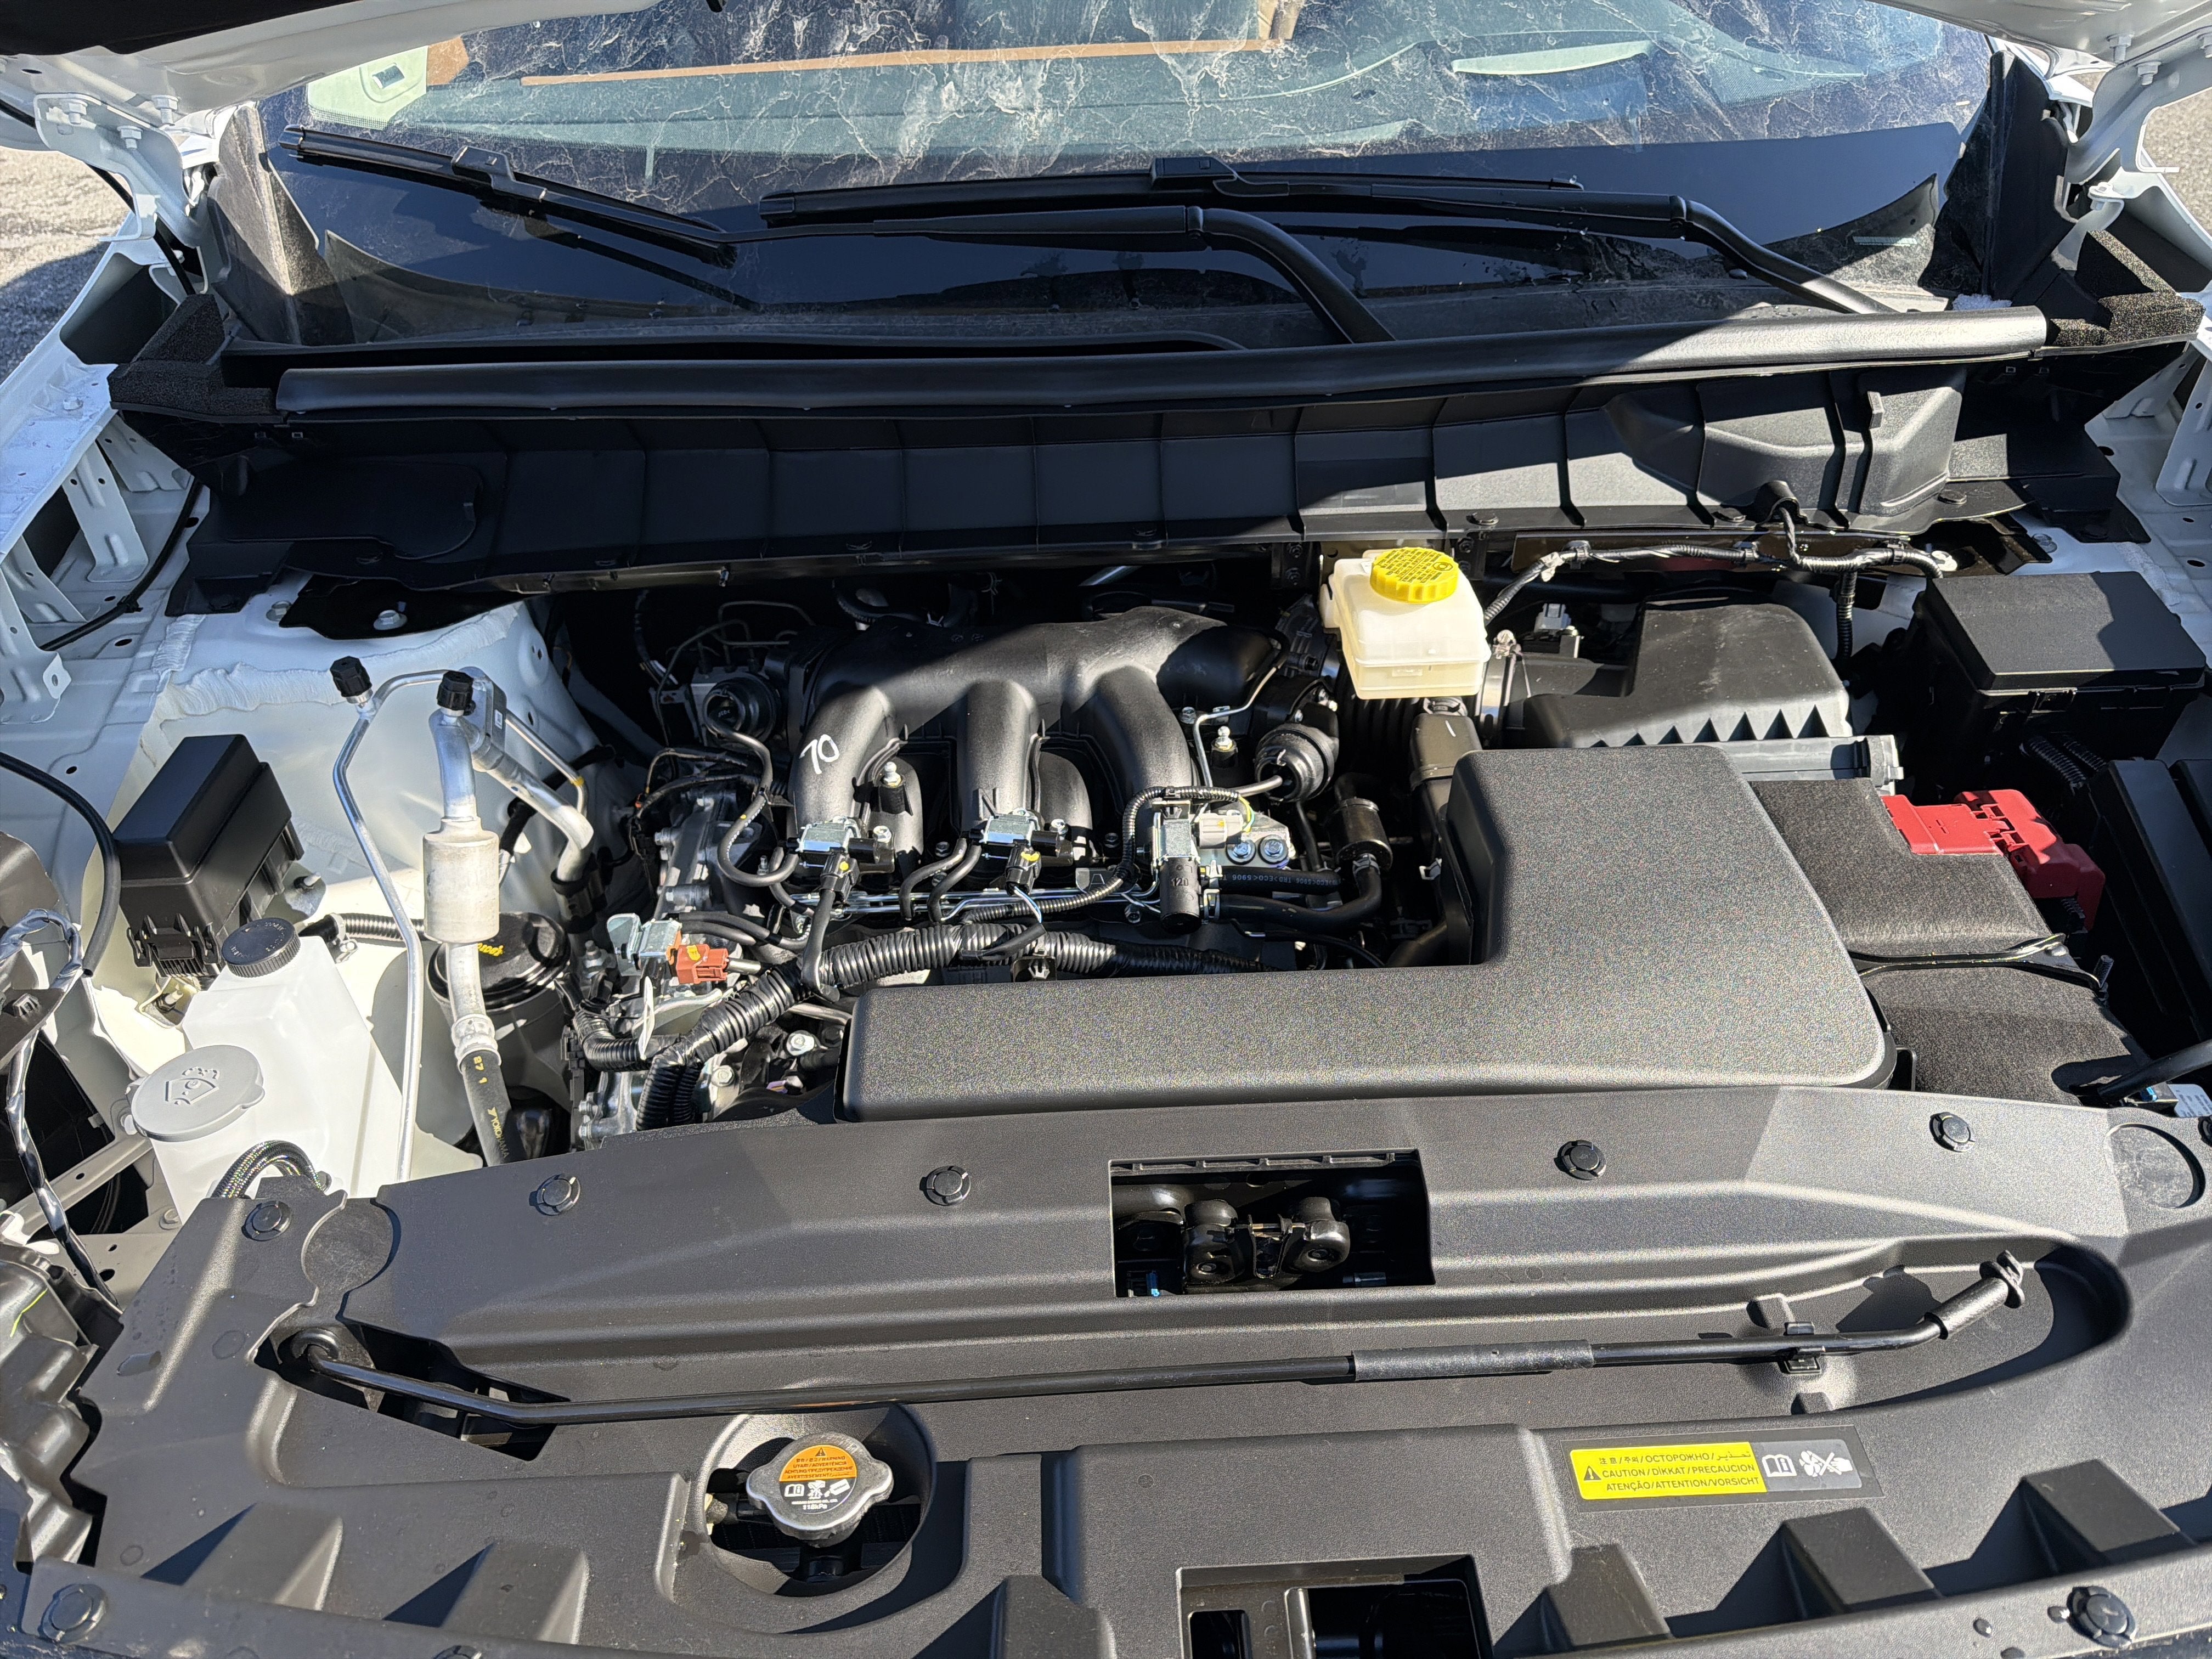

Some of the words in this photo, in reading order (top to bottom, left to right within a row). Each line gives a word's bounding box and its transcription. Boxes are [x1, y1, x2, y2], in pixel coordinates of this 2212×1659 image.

[799, 733, 839, 775] 10
[491, 1117, 509, 1159] YOKOHAMA
[1602, 1469, 1645, 1477] CAUTION
